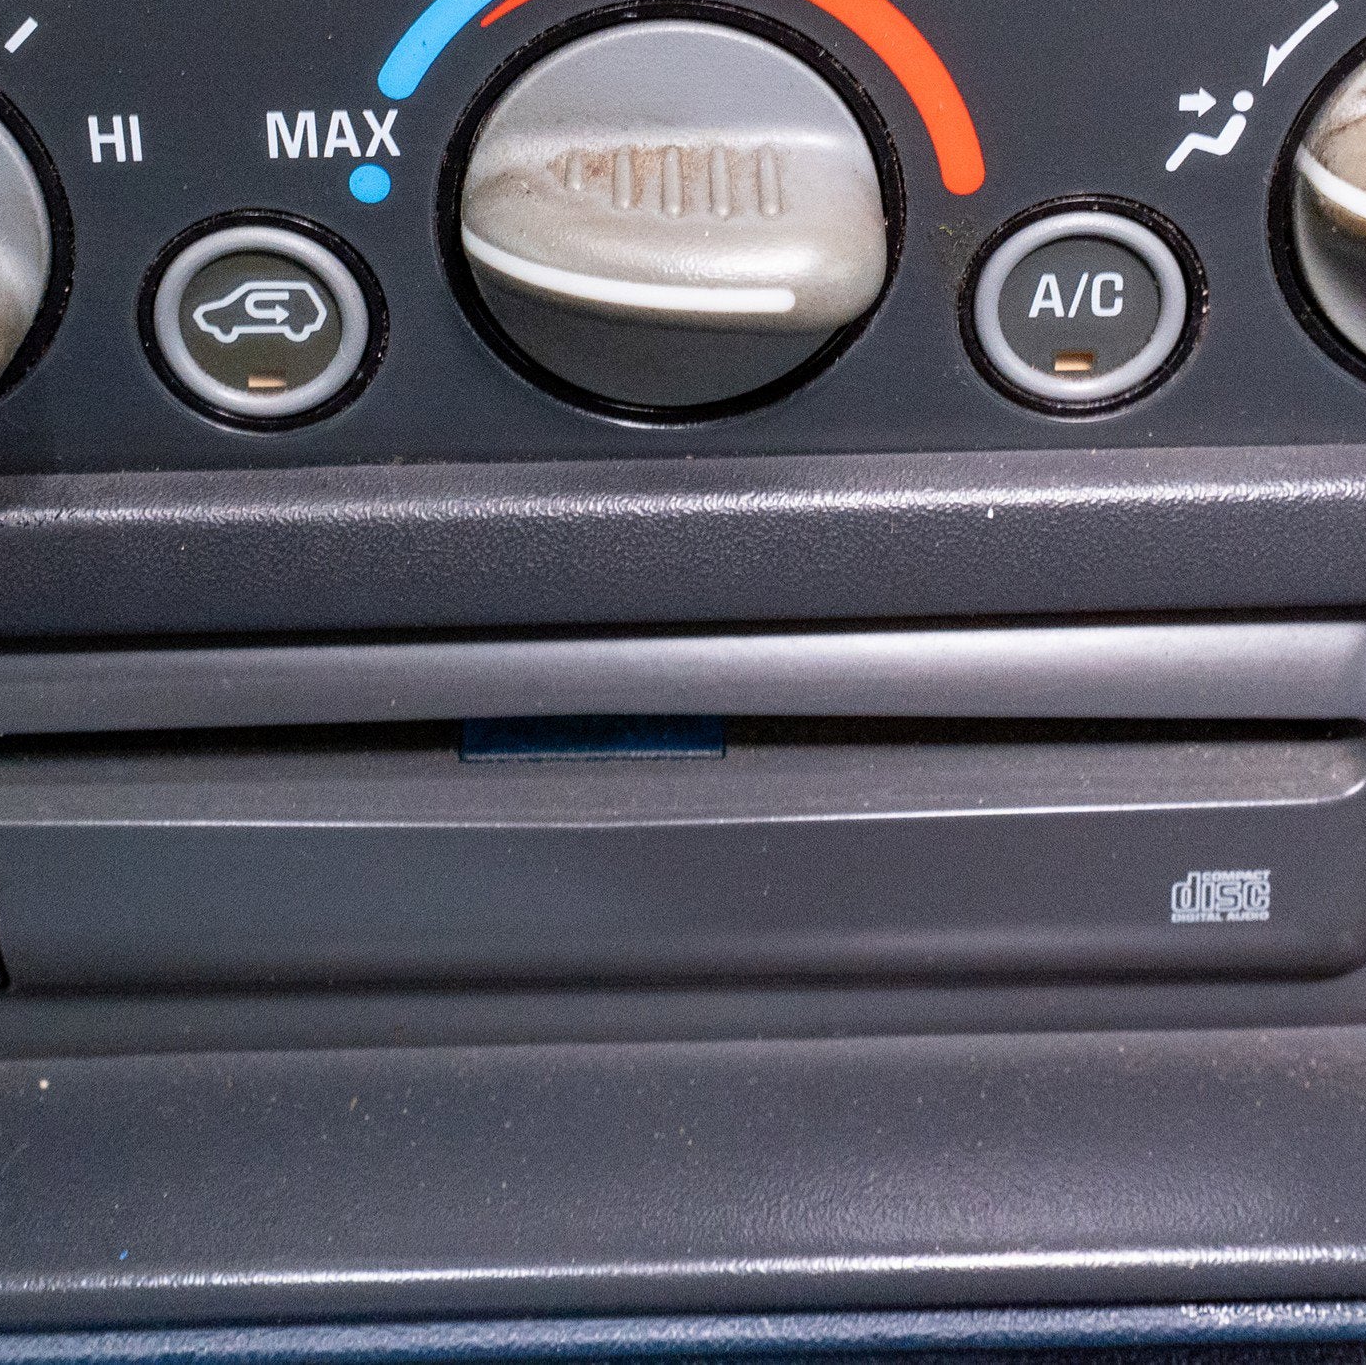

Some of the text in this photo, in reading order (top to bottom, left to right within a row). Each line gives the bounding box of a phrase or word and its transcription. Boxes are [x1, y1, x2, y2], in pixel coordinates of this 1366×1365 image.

[87, 115, 143, 163] HI
[266, 109, 401, 159] MAX
[1028, 272, 1124, 318] A/C
